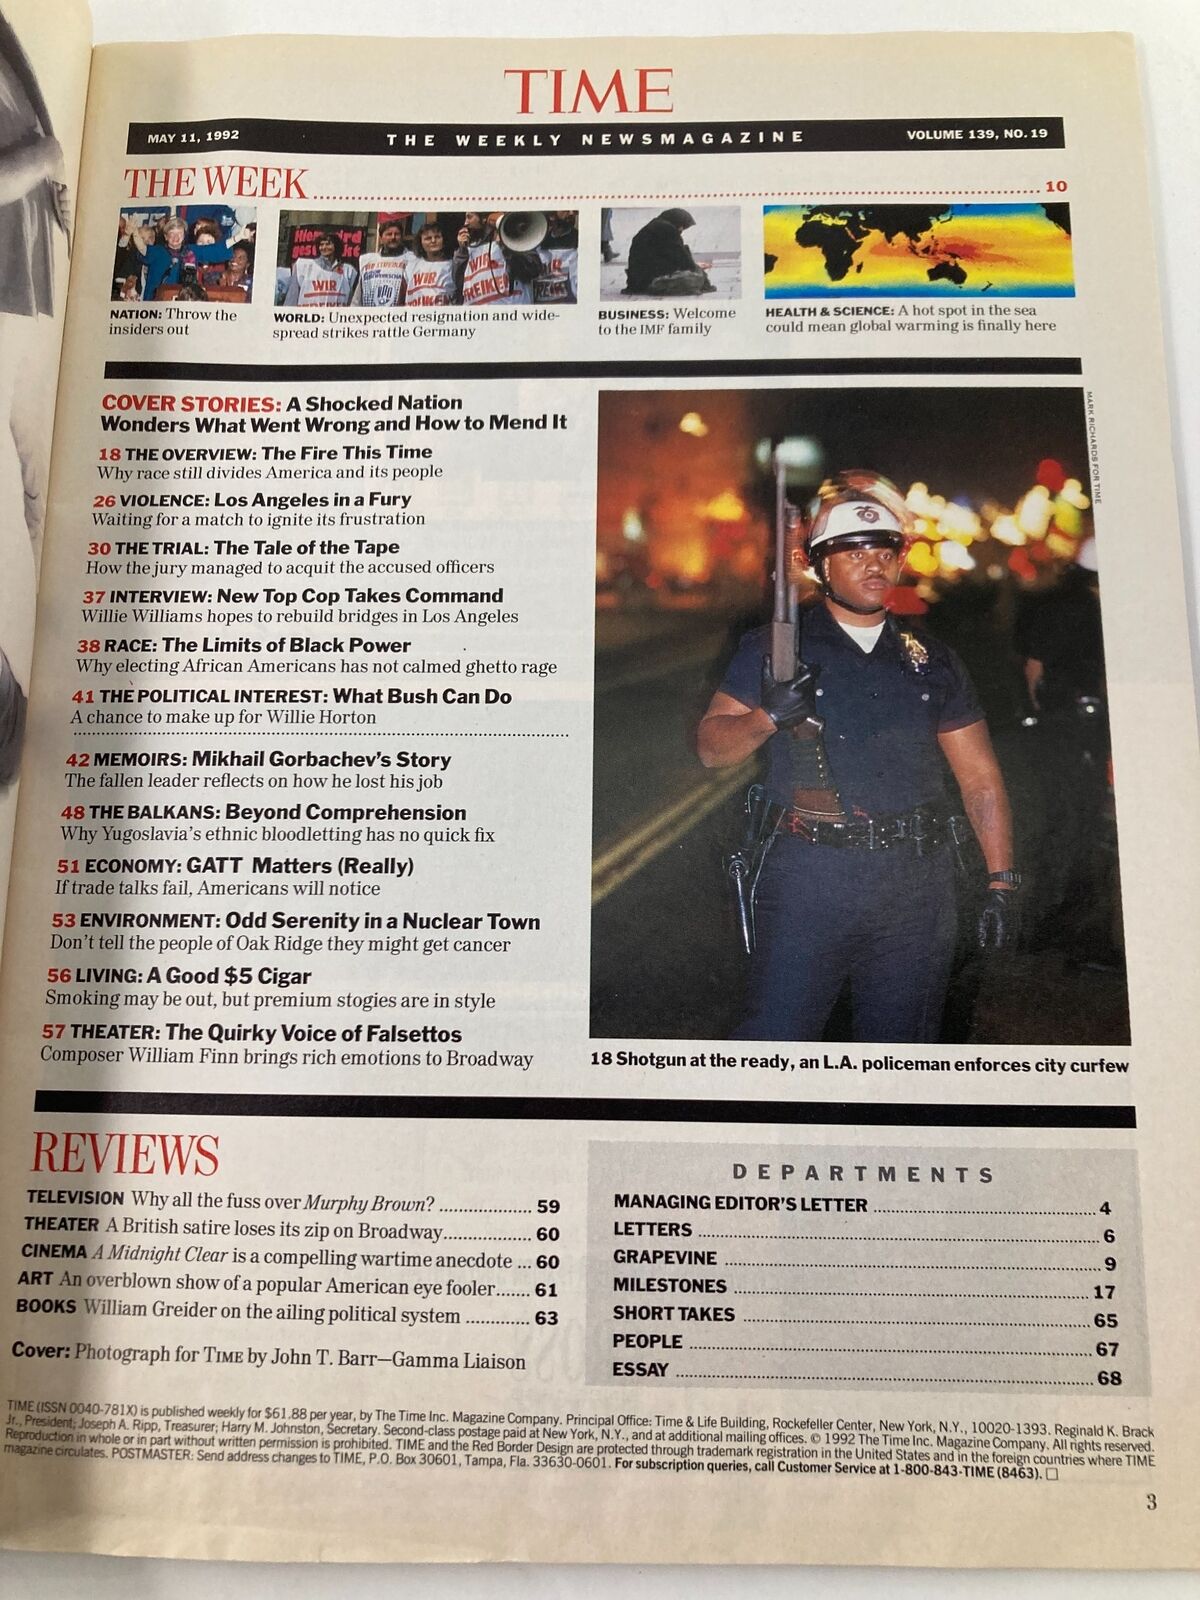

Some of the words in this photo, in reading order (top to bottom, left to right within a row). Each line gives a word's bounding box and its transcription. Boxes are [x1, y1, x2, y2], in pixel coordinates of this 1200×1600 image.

[504, 69, 674, 114] TIME
[147, 134, 174, 145] MAY
[178, 133, 201, 145] 11,
[206, 129, 240, 142] 1992
[387, 134, 436, 147] THE
[456, 134, 563, 147] WEEKLY
[582, 130, 804, 146] NEWSMAGAZINE
[906, 129, 964, 142] VOLUME
[968, 128, 1000, 143] 139,
[1004, 128, 1027, 140] NO.
[1030, 128, 1048, 140] 19
[124, 167, 195, 199] THE
[202, 165, 309, 199] WEEK
[1046, 181, 1068, 193] 10
[312, 280, 337, 291] WIR
[413, 271, 437, 286] WIR
[110, 310, 162, 319] NATION:
[166, 308, 212, 320] Throw
[215, 309, 237, 322] the
[274, 313, 325, 323] WORLD:
[329, 311, 407, 326] Unexpected
[412, 310, 489, 325] resignation
[492, 310, 517, 321] and
[522, 310, 560, 321] wide-
[598, 310, 669, 320] BUSINESS:
[673, 307, 736, 319] Welcome
[765, 307, 817, 317] HEALTH
[820, 307, 830, 317] &
[833, 306, 894, 316] SCIENCE:
[898, 305, 909, 316] A
[913, 305, 935, 316] hot
[938, 306, 967, 318] spot
[972, 305, 985, 316] in
[989, 305, 1011, 315] the
[1014, 308, 1037, 316] sea
[109, 323, 164, 335] insiders
[167, 324, 189, 336] out
[272, 327, 318, 341] spread
[322, 327, 369, 339] strikes
[372, 326, 410, 338] rattle
[413, 326, 476, 340] Germany
[598, 324, 611, 336] to
[615, 324, 637, 335] the
[640, 324, 665, 335] IMF
[668, 322, 712, 337] family
[766, 321, 803, 333] could
[808, 323, 846, 332] mean
[850, 320, 891, 334] global
[895, 320, 959, 334] warming
[963, 320, 974, 331] is
[978, 319, 1021, 334] finally
[1025, 319, 1057, 331] here
[102, 394, 176, 411] COVER
[181, 396, 281, 412] STORIES:
[286, 396, 301, 412] A
[305, 395, 393, 412] Shocked
[398, 394, 462, 410] Nation
[1086, 391, 1094, 415] MARK
[101, 415, 190, 433] Wonders
[195, 417, 246, 433] What
[251, 418, 301, 433] Went
[305, 417, 371, 435] Wrong
[374, 415, 410, 432] and
[416, 415, 461, 431] How
[464, 416, 485, 431] to
[489, 414, 547, 430] Mend
[553, 414, 568, 430] It
[1088, 417, 1098, 462] RICHARDS
[1092, 464, 1100, 481] FOR
[93, 495, 116, 508] 26
[120, 494, 210, 507] VIOLENCE:
[214, 492, 248, 507] Los
[251, 492, 329, 510] Angeles
[334, 492, 350, 507] in
[354, 496, 364, 506] a
[369, 491, 412, 509] Fury
[1094, 483, 1102, 504] TIME
[83, 591, 106, 604] 37
[110, 590, 212, 603] INTERVIEW:
[217, 588, 259, 603] New
[263, 588, 297, 606] Top
[302, 588, 340, 606] Cop
[344, 588, 401, 603] Takes
[405, 587, 504, 603] Command
[66, 753, 90, 767] 42
[94, 752, 187, 766] MEMOIRS:
[192, 750, 265, 766] Mikhail
[396, 751, 452, 771] Story
[57, 859, 79, 873] 51
[85, 859, 182, 873] ECONOMY:
[186, 856, 244, 873] GATT
[252, 857, 332, 874] Matters
[338, 857, 414, 878] (Really)
[47, 968, 71, 983] 56
[76, 968, 143, 983] LIVING:
[146, 966, 162, 983] A
[166, 966, 219, 984] Good
[224, 965, 253, 987] $5
[258, 967, 312, 988] Cigar
[591, 1052, 613, 1065] 18
[616, 1051, 686, 1069] Shotgun
[690, 1053, 706, 1067] at
[709, 1053, 737, 1068] the
[741, 1054, 795, 1072] ready,
[799, 1058, 819, 1069] an
[823, 1055, 857, 1070] L.A.
[862, 1056, 951, 1073] policeman
[954, 1057, 1031, 1072] enforces
[1035, 1058, 1067, 1076] city
[1070, 1058, 1130, 1073] curfew
[31, 1131, 220, 1176] REVIEWS
[733, 1163, 994, 1184] DEPARTMENTS
[26, 1189, 124, 1205] TELEVISION
[131, 1190, 170, 1211] Why
[172, 1192, 192, 1207] all
[197, 1192, 223, 1208] the
[226, 1192, 261, 1209] fuss
[264, 1197, 302, 1210] over
[302, 1194, 369, 1215] Murphy
[370, 1195, 435, 1212] Brown?
[537, 1199, 560, 1214] 59
[614, 1194, 711, 1210] MANAGING
[801, 1197, 868, 1213] LETTER
[1099, 1201, 1112, 1215] 4
[614, 1221, 693, 1237] LETTERS
[1103, 1229, 1115, 1243] 6
[613, 1249, 717, 1265] GRAPEVINE
[1104, 1257, 1117, 1271] 9
[613, 1277, 727, 1294] MILESTONES
[1093, 1285, 1116, 1300] 17
[613, 1305, 675, 1321] SHORT
[677, 1306, 735, 1322] TAKES
[1094, 1313, 1118, 1328] 65
[613, 1333, 683, 1349] PEOPLE
[1096, 1341, 1119, 1357] 67
[613, 1362, 670, 1377] ESSAY
[1097, 1370, 1122, 1386] 68
[4, 1443, 53, 1457] magazine
[55, 1445, 108, 1459] circulates.
[112, 1447, 193, 1460] POSTMASTER:
[197, 1450, 224, 1461] Send
[227, 1451, 269, 1462] address
[272, 1452, 317, 1465] changes
[320, 1453, 330, 1463] to
[334, 1452, 365, 1465] TIME,
[369, 1453, 392, 1465] P.O.
[396, 1453, 416, 1465] Box
[419, 1453, 461, 1467] 30601,
[465, 1454, 506, 1468] Tampa,
[510, 1455, 529, 1467] Fla.
[533, 1455, 611, 1469] 33630-0601.
[615, 1457, 633, 1469] For
[636, 1458, 704, 1472] subscription
[707, 1460, 751, 1473] queries,
[755, 1460, 774, 1472] call
[778, 1461, 832, 1473] Customer
[835, 1462, 876, 1475] Service
[879, 1464, 890, 1475] at
[893, 1464, 994, 1478] 1-800-843-TIME
[997, 1466, 1042, 1480] (8463).
[1147, 1493, 1157, 1510] 3
